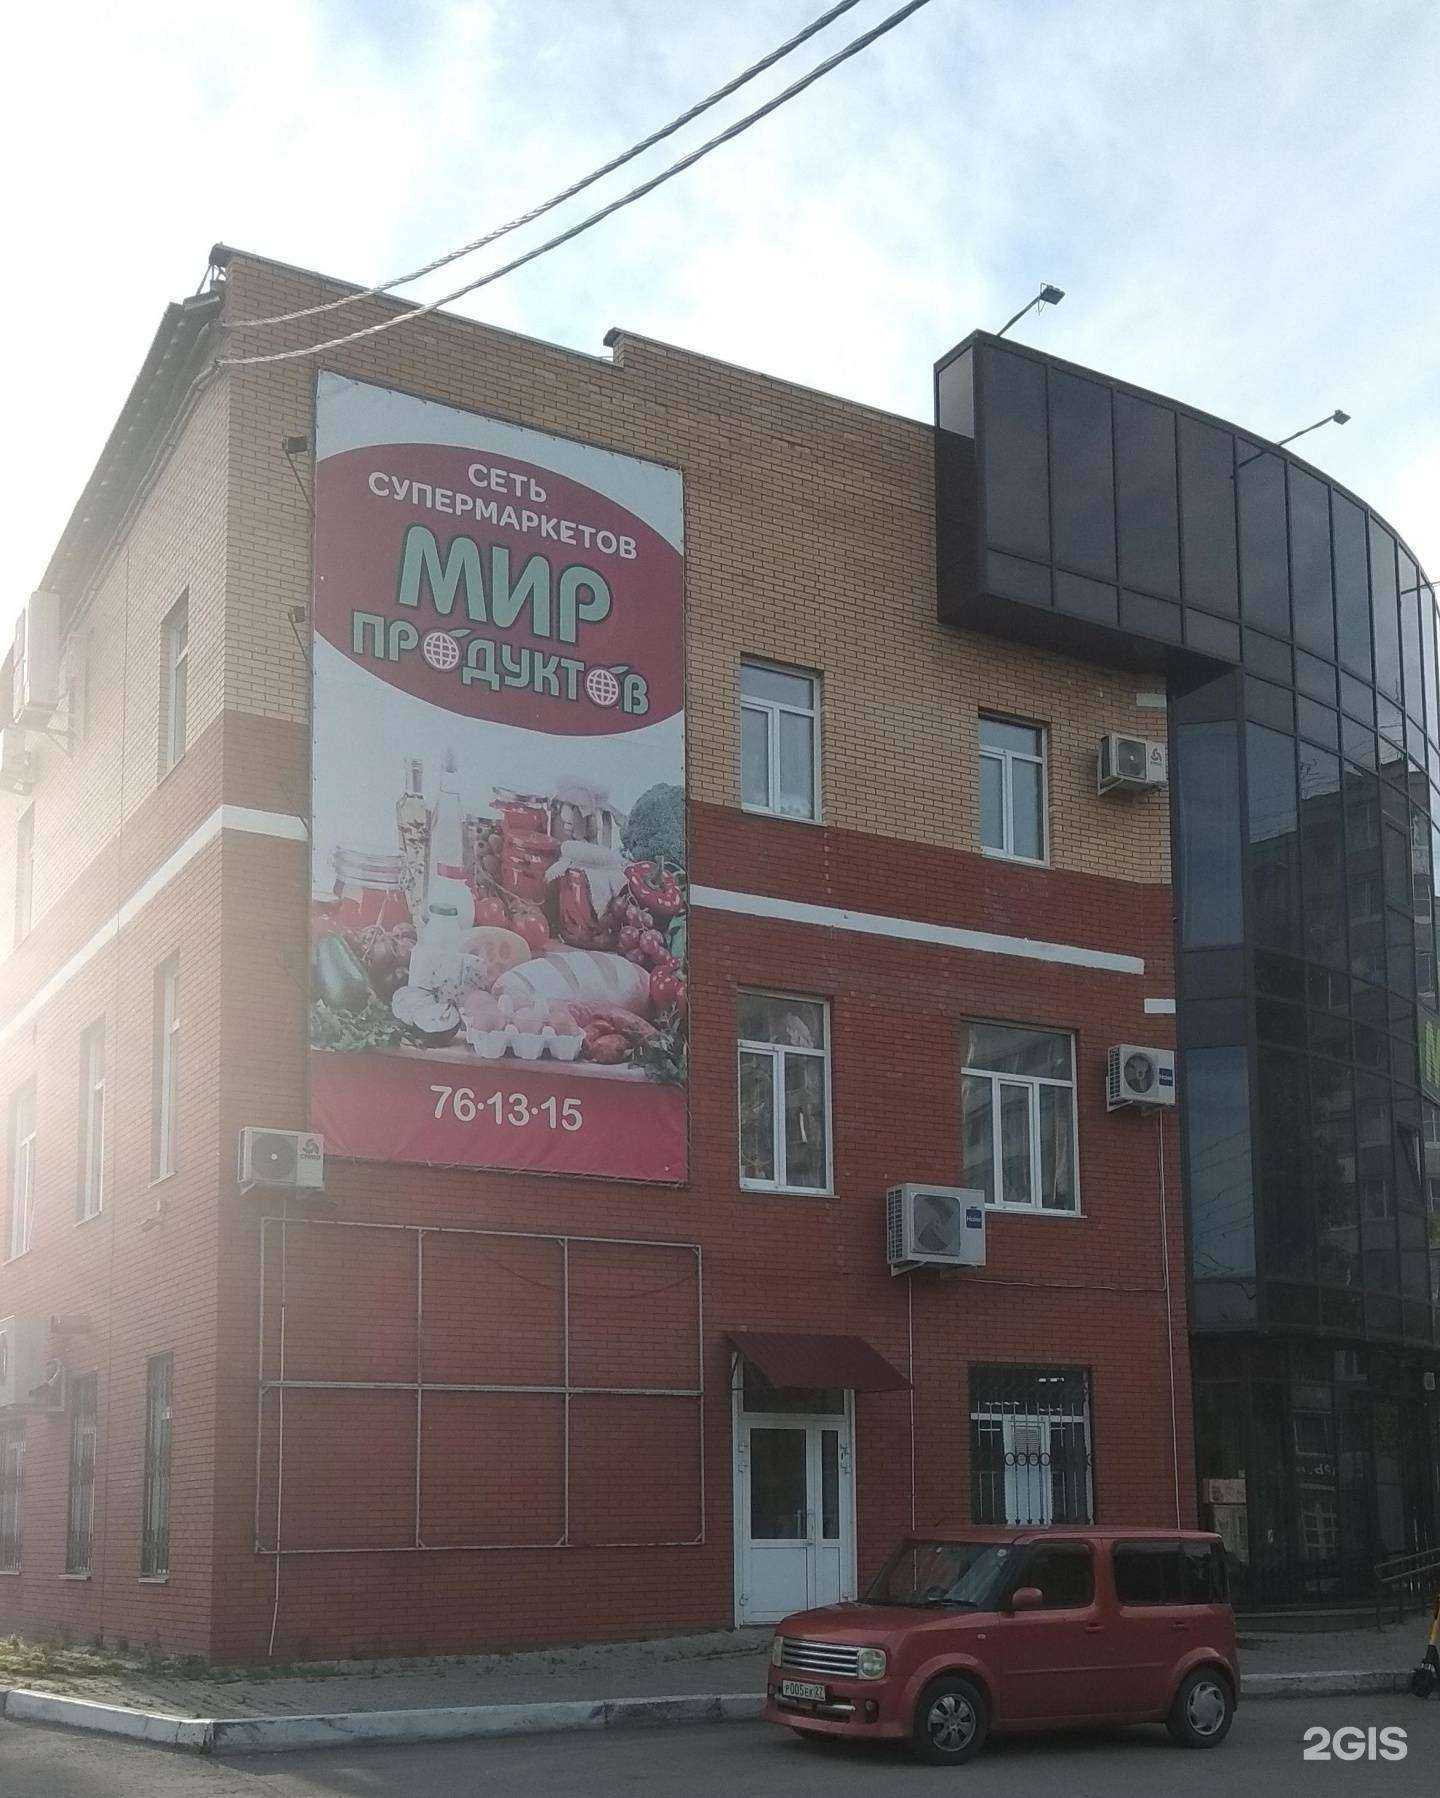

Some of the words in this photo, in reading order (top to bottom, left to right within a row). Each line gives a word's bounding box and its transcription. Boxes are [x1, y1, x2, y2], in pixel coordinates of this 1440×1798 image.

[368, 471, 639, 561] СУПЕРМАРКЕТОВ
[467, 463, 548, 503] СЕТЬ
[398, 524, 612, 645] МИР
[352, 610, 650, 716] ПРОДУКТОВ
